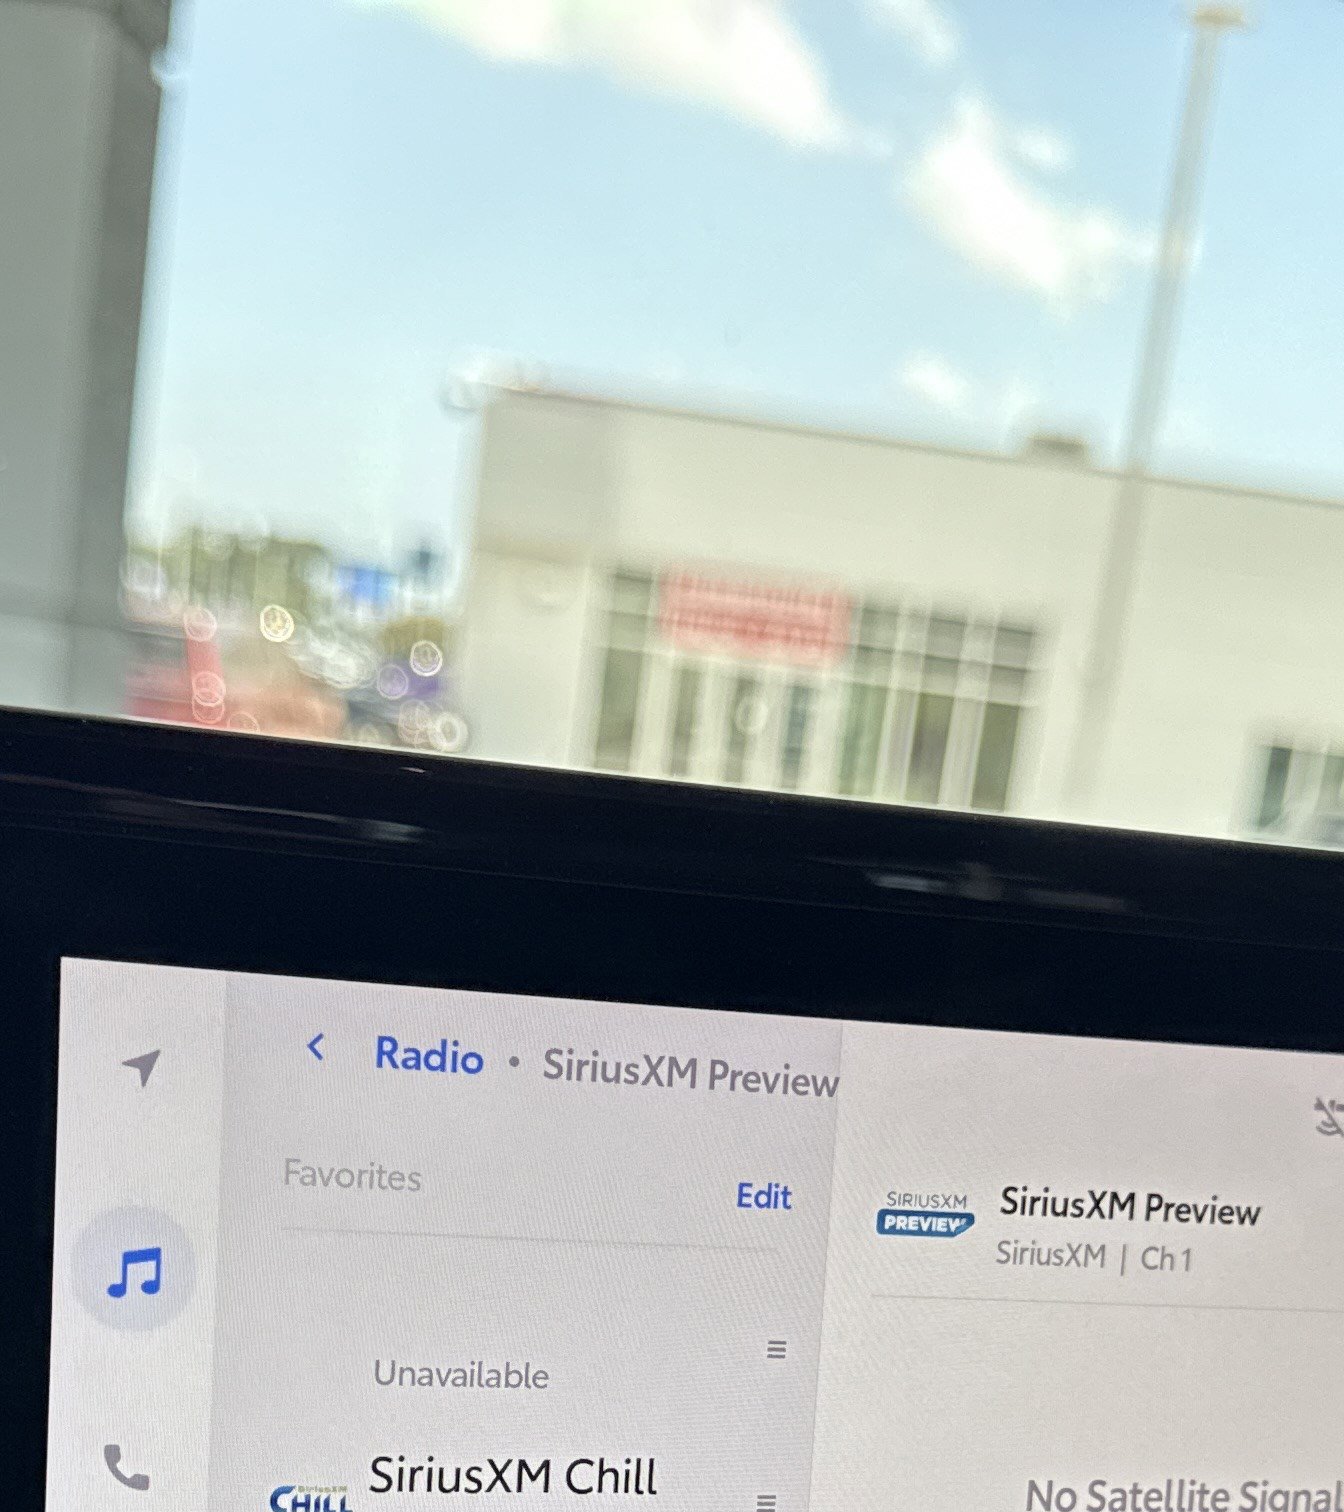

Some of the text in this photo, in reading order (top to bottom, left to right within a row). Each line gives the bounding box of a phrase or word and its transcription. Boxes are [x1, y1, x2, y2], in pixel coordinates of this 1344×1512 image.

[376, 1036, 840, 1097] Radio SiriusXM Preview
[284, 1158, 421, 1192] Favorites
[737, 1182, 791, 1210] Edit
[886, 1191, 968, 1210] SIRIUSXM
[1000, 1186, 1261, 1225] SiriusXM Preview
[995, 1240, 1106, 1268] SiriusXM
[375, 1360, 549, 1389] Unavailable
[370, 1455, 657, 1495] SiriusXM Chill
[1026, 1480, 1077, 1512] No
[1087, 1479, 1230, 1512] Satellite
